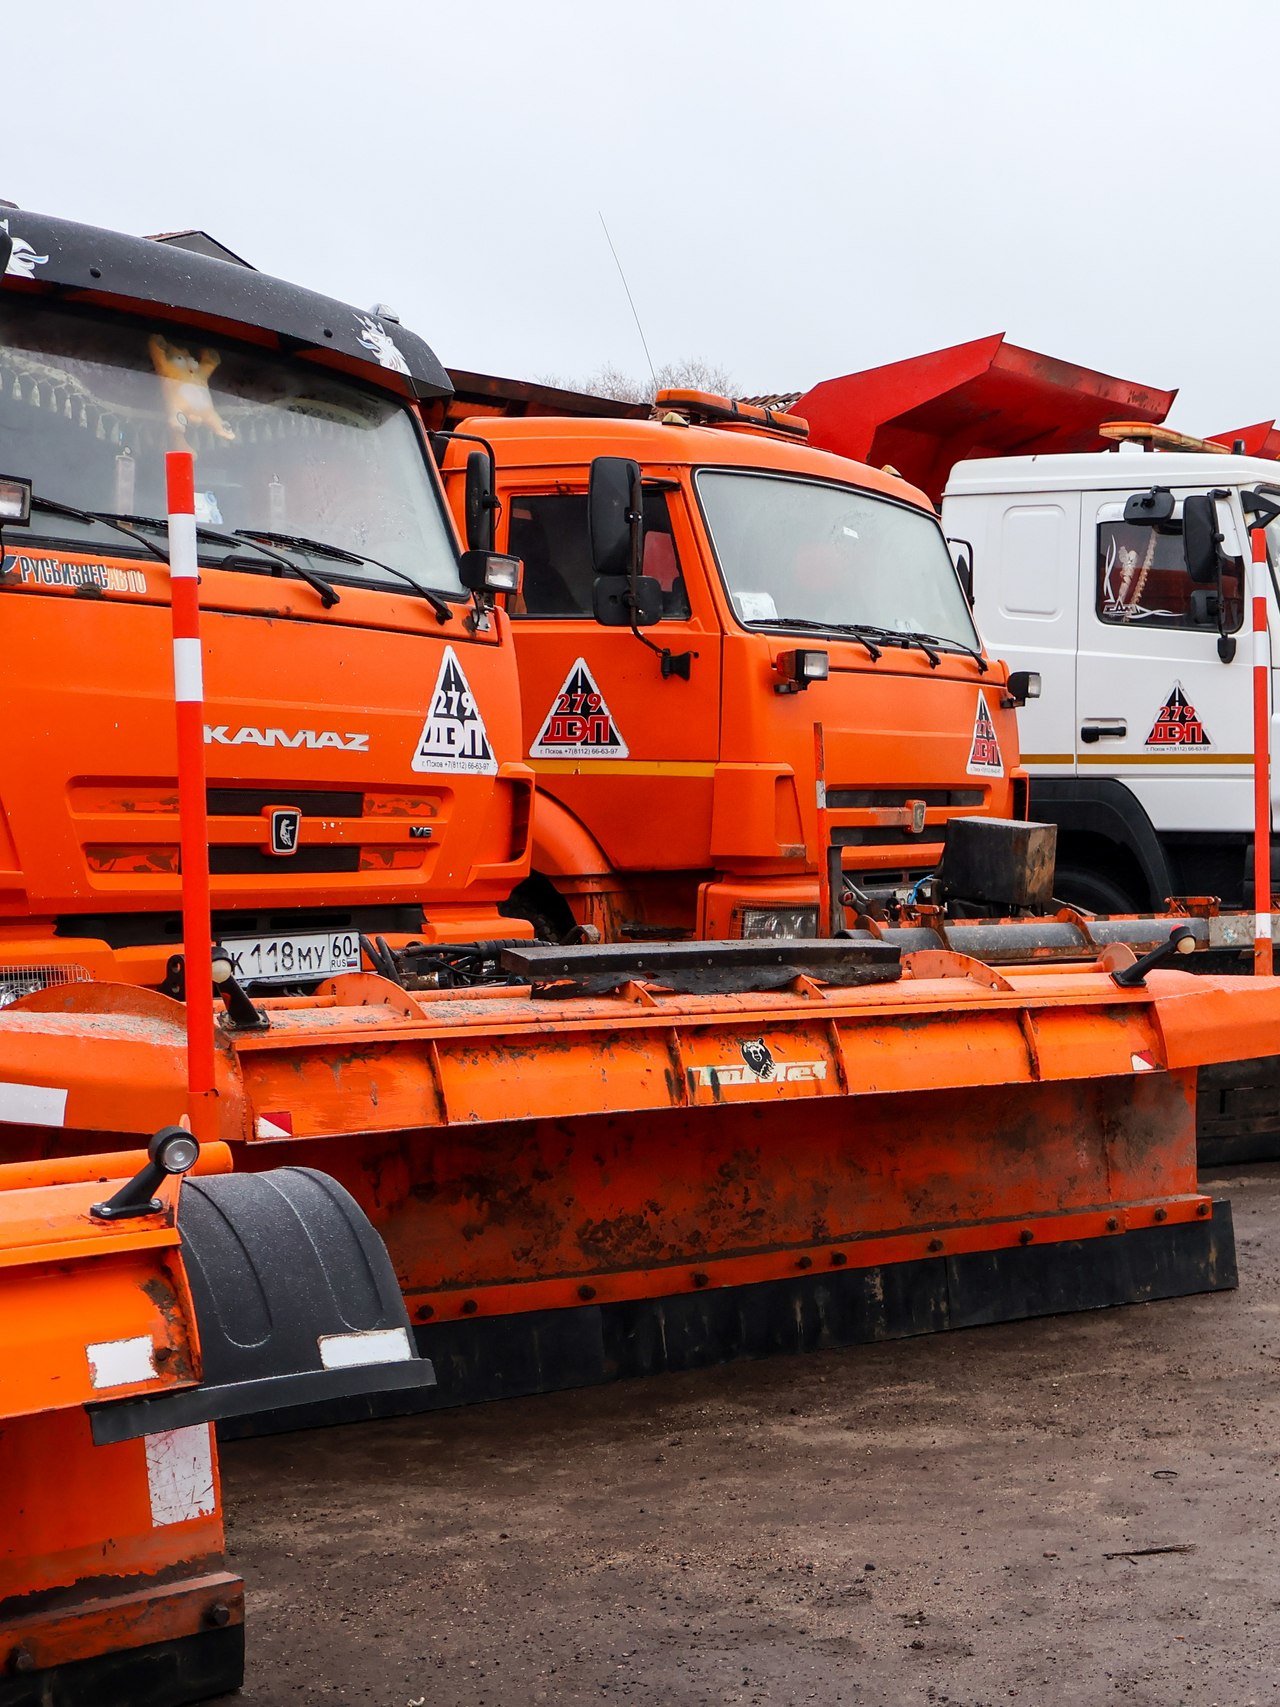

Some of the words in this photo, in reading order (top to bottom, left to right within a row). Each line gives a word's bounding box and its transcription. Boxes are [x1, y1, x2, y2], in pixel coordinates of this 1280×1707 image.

[435, 689, 475, 717] 279
[558, 693, 602, 713] 279
[1159, 705, 1196, 721] 279
[203, 725, 370, 751] KAMAZ
[423, 718, 483, 757] ДЭП
[542, 714, 610, 744] ДЭП
[1147, 721, 1203, 743] ДЭП
[971, 738, 998, 764] ДЭП
[332, 935, 353, 958] 60
[331, 959, 347, 968] RUS
